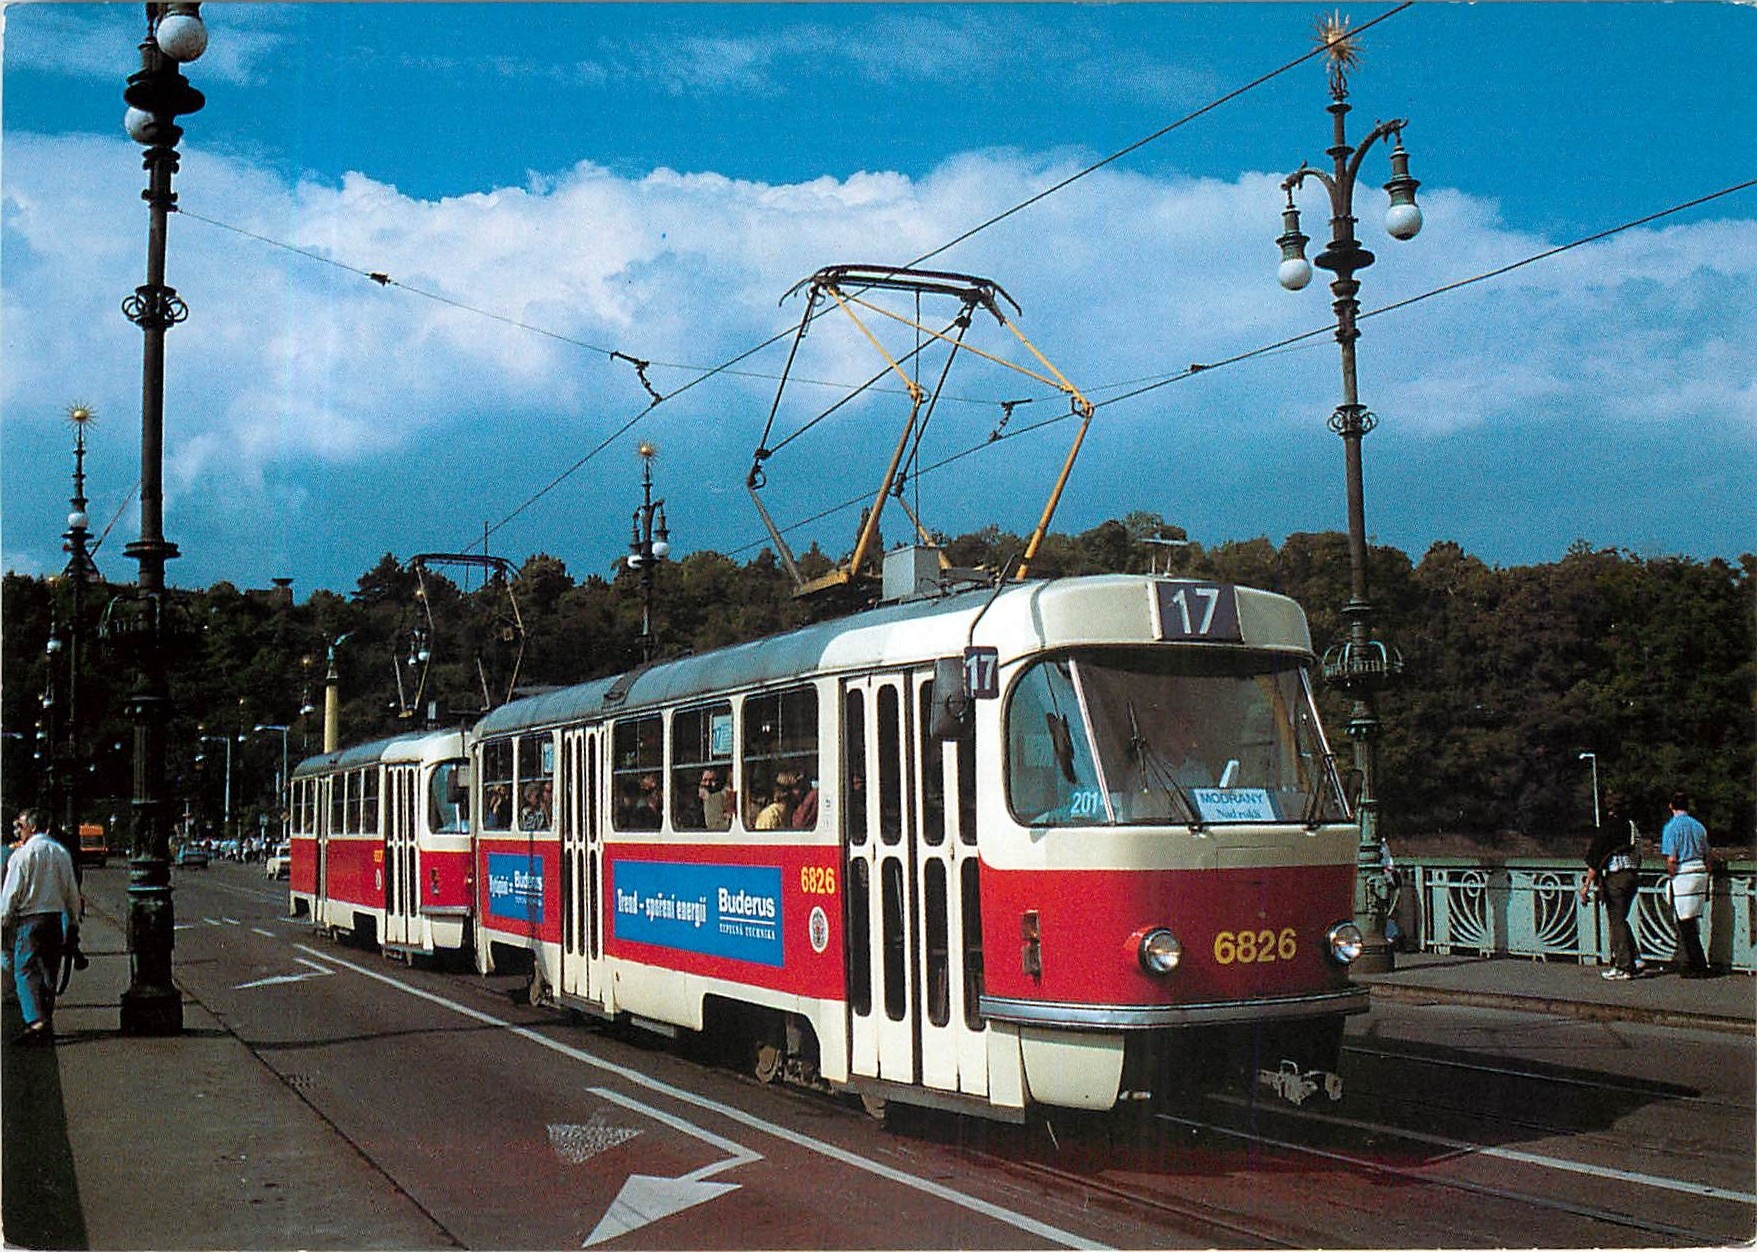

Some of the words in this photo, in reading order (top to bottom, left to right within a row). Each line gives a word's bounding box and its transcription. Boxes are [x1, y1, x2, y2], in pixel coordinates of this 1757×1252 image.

[1171, 587, 1220, 635] 17
[965, 653, 997, 692] 17
[1070, 791, 1099, 814] 201
[801, 866, 836, 895] 6826
[718, 887, 775, 918] Buderus
[1213, 928, 1298, 965] 6826
